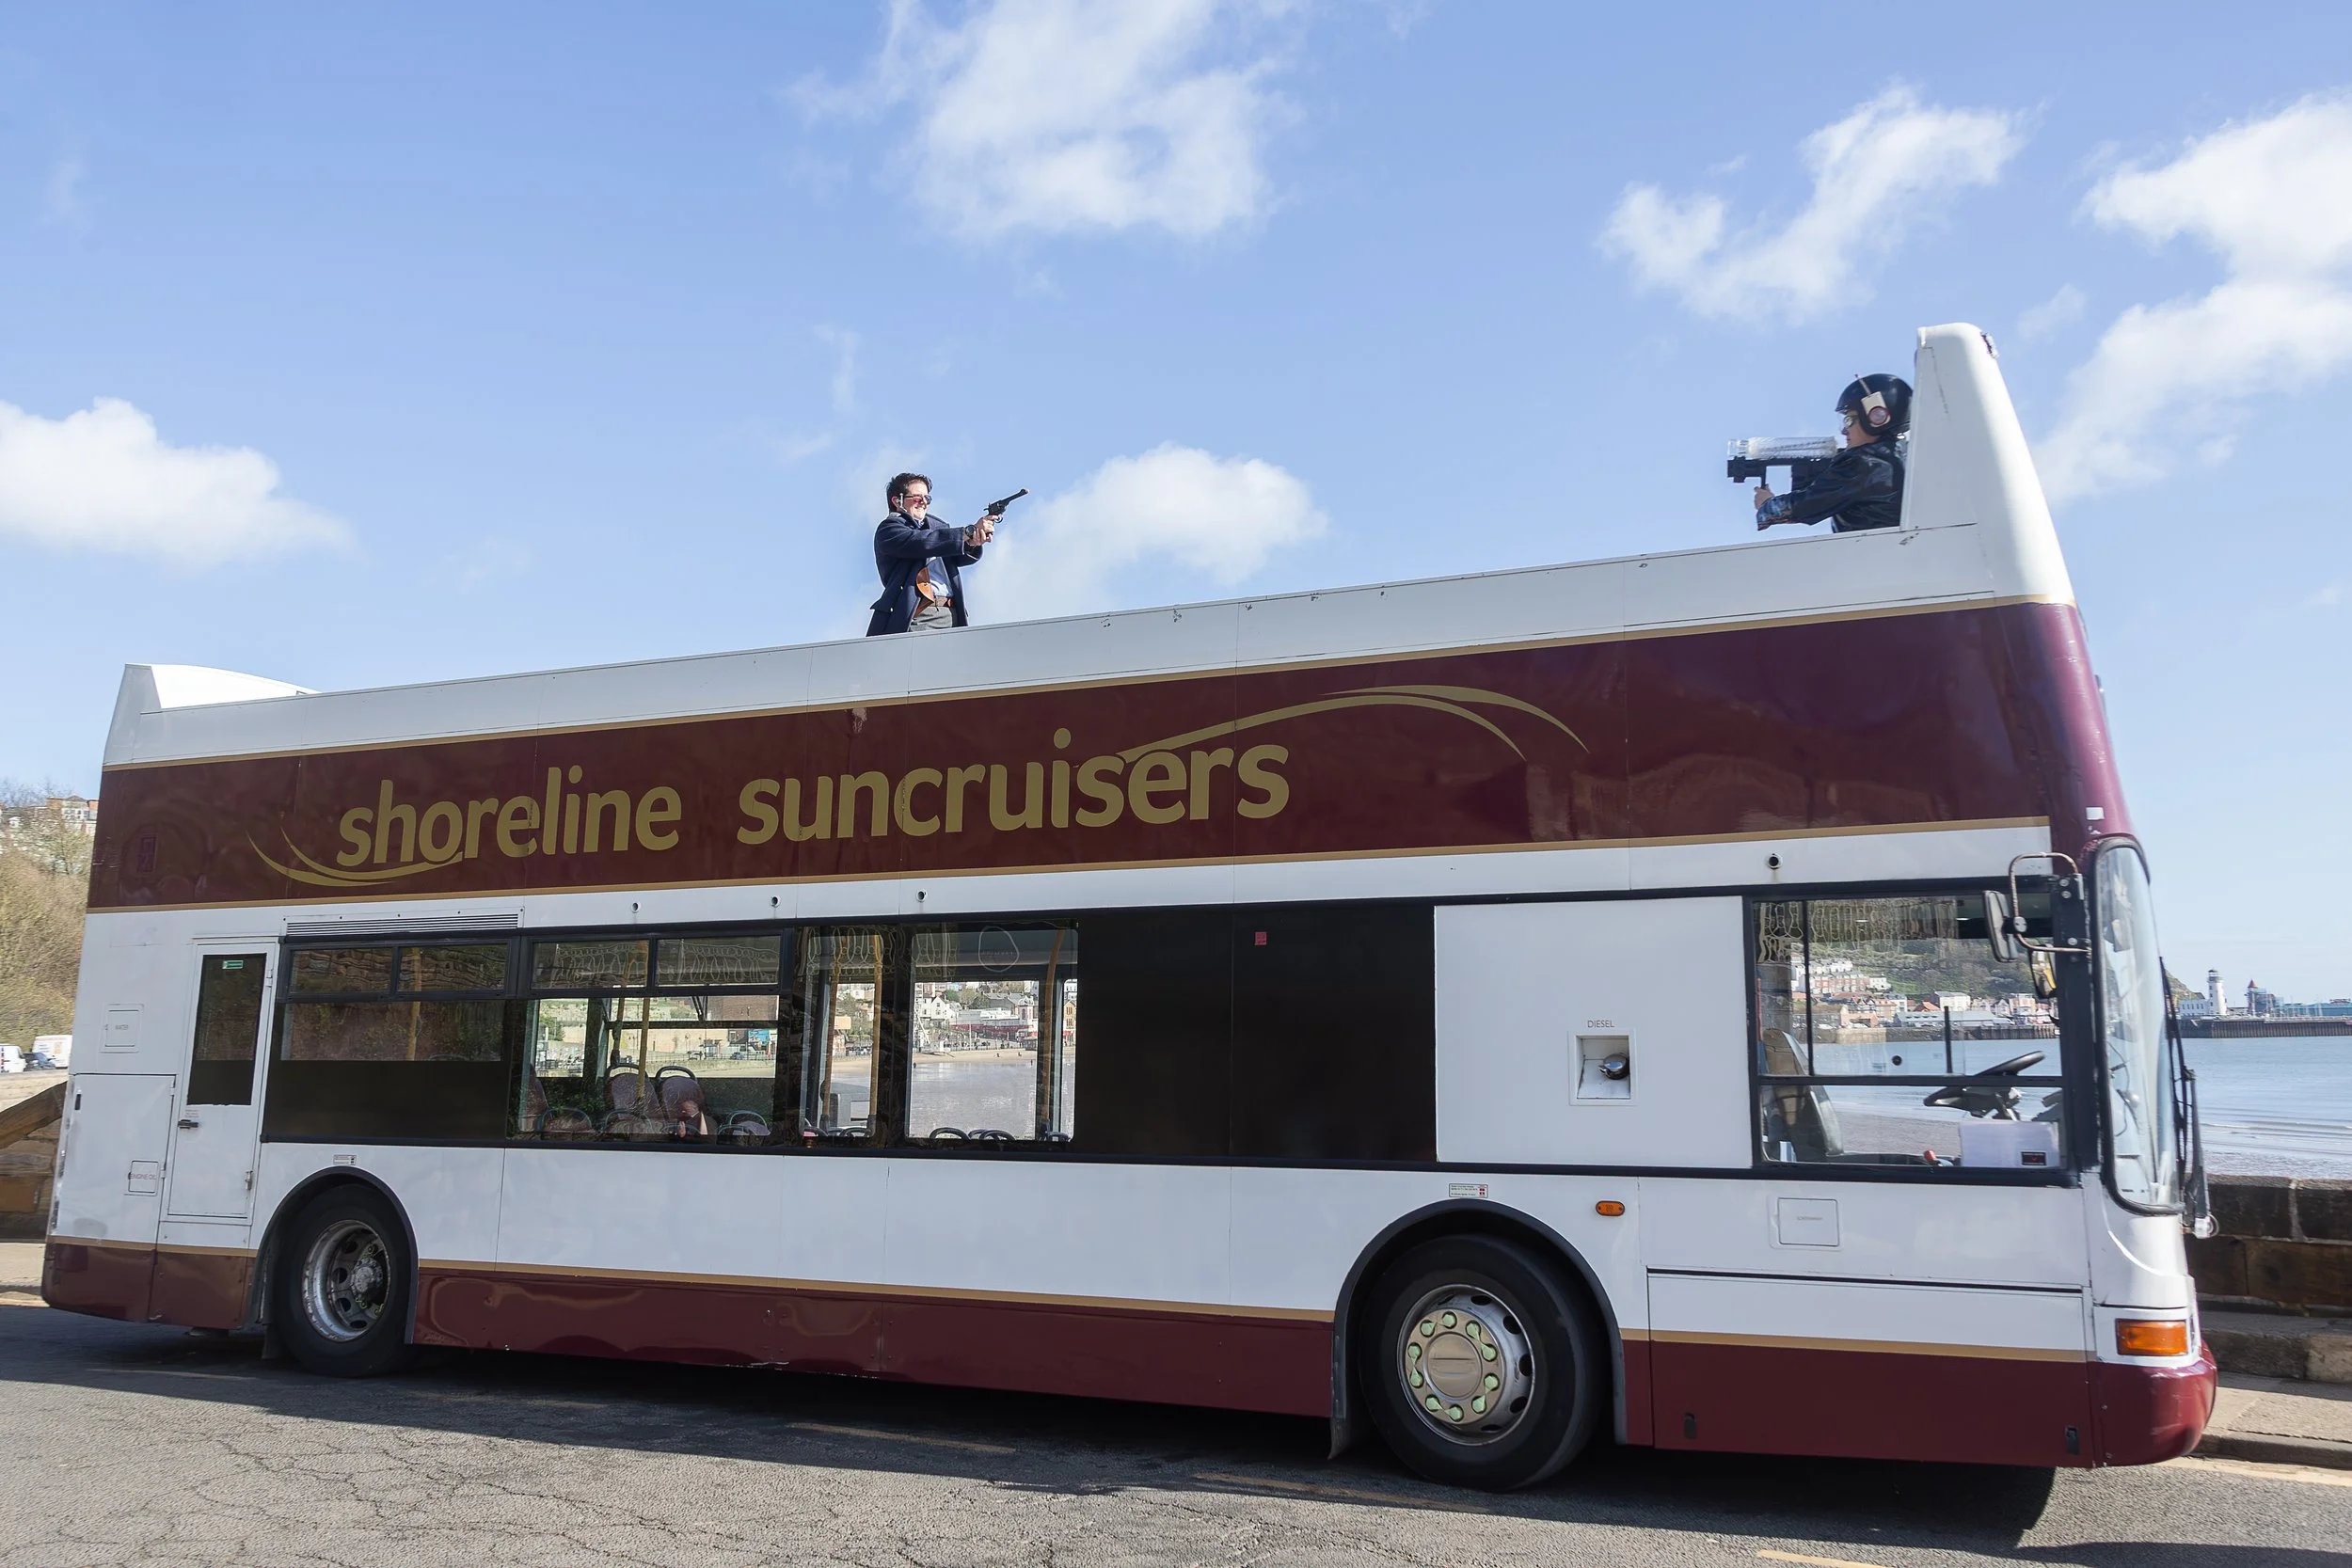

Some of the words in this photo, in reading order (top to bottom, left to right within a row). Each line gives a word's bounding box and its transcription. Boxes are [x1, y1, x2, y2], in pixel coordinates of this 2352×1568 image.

[337, 766, 681, 867] shoreline
[738, 727, 1290, 845] suncruisers
[1587, 1020, 1615, 1028] DIESEL
